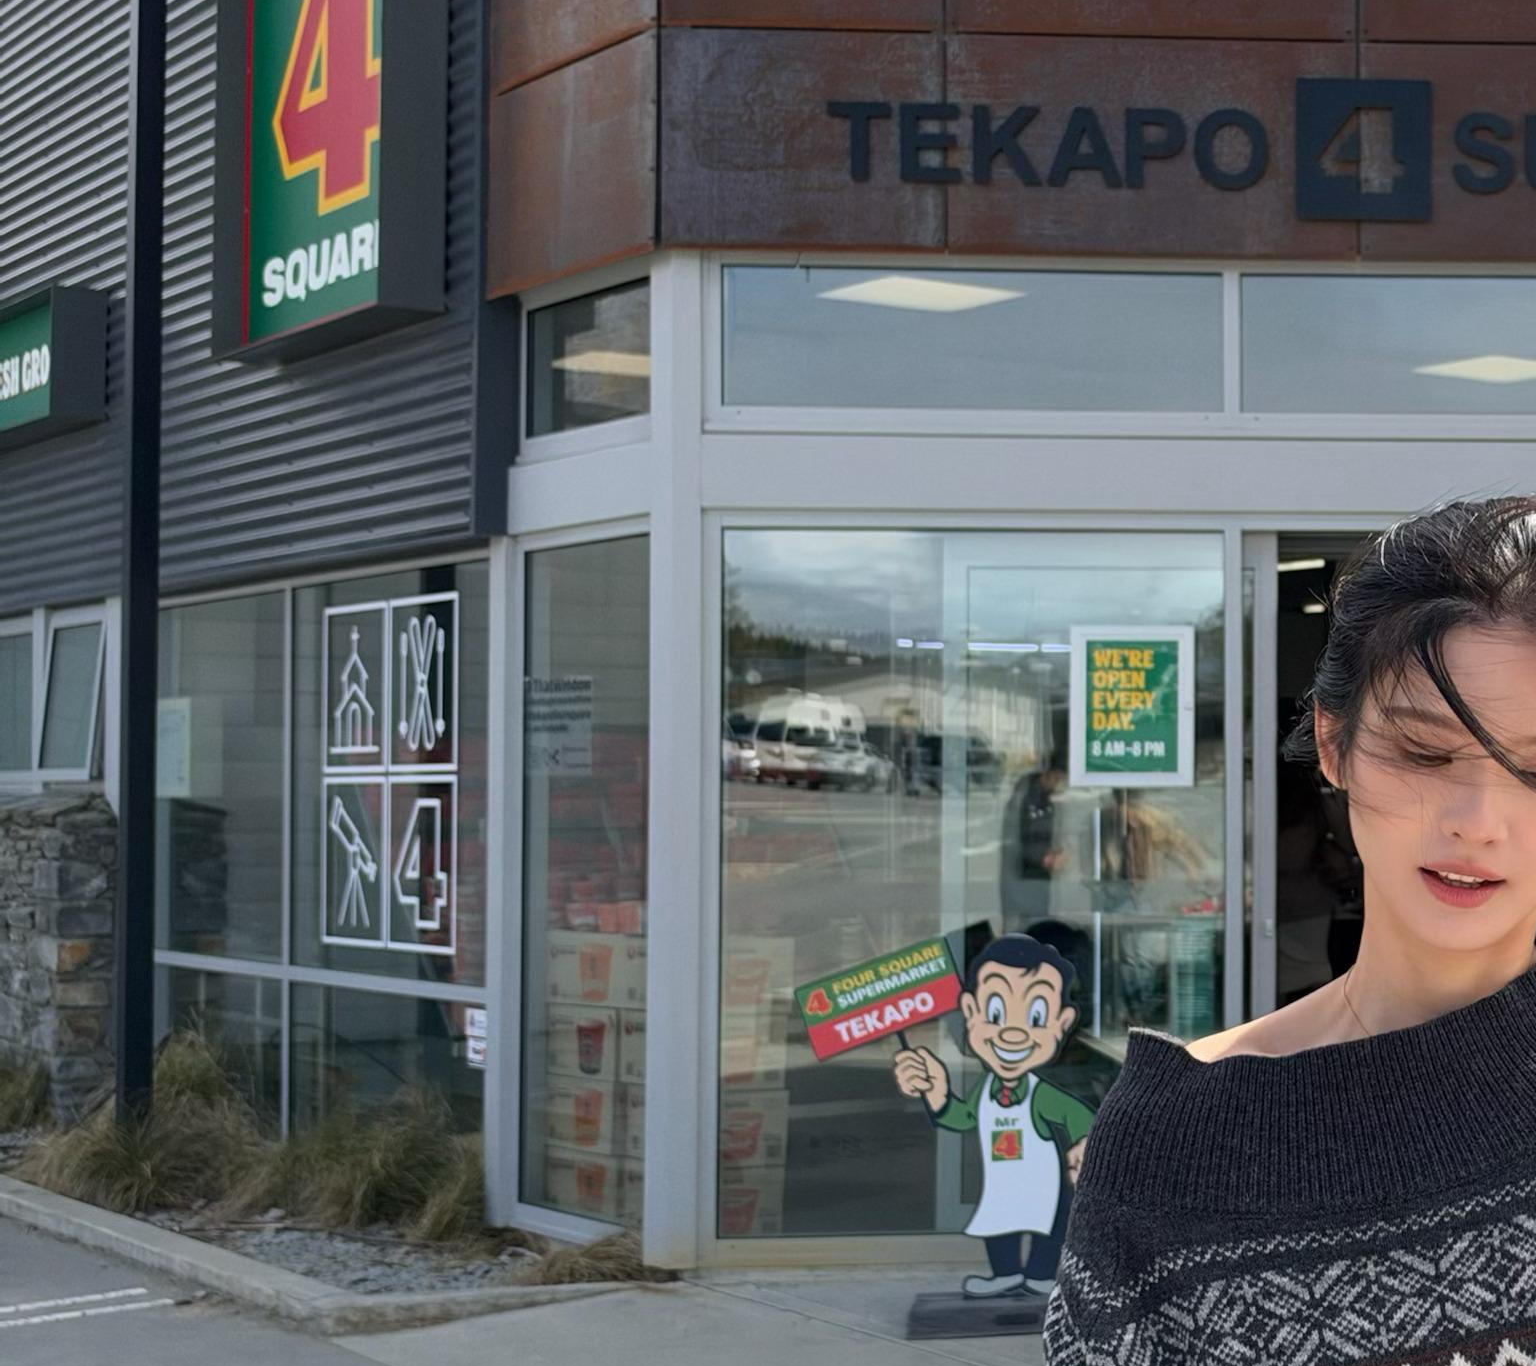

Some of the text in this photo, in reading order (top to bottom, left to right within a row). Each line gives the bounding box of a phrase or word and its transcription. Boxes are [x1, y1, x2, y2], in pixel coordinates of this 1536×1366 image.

[827, 101, 1269, 191] TEKAPO
[1094, 649, 1154, 668] WE'RE
[1093, 671, 1145, 688] OPEN
[1092, 691, 1155, 709] EVERY
[1093, 712, 1135, 730] DAY.
[1144, 741, 1165, 756] PM
[394, 798, 447, 929] 4
[805, 957, 947, 1016] 4 SUPERMARKET
[831, 943, 944, 995] FOUR SQUARE
[834, 991, 935, 1042] TEKAPO
